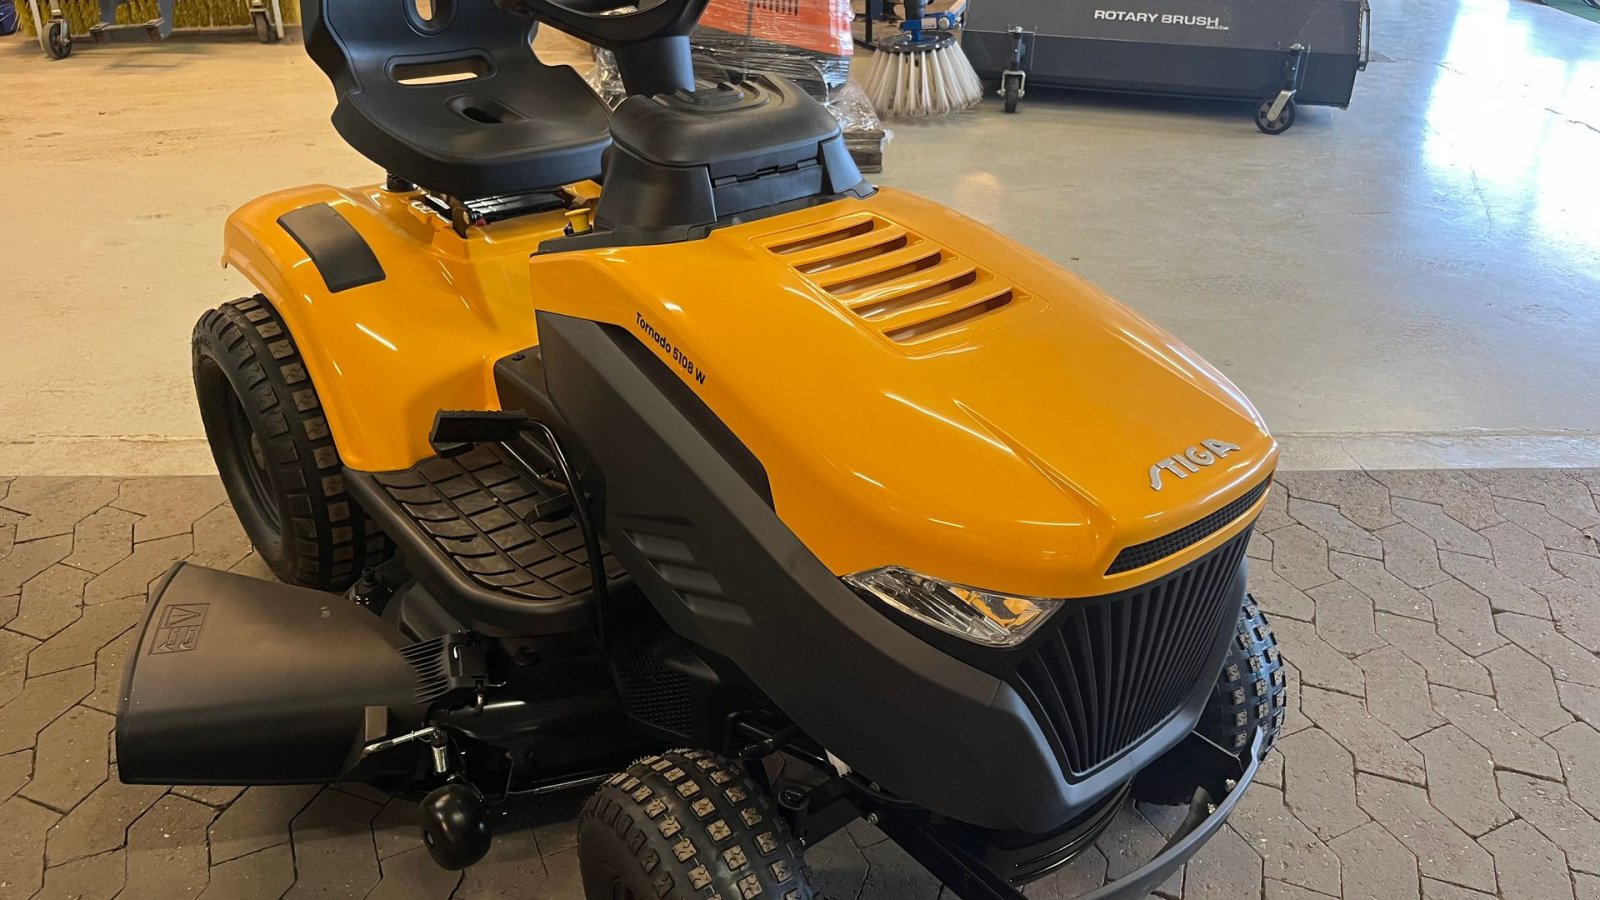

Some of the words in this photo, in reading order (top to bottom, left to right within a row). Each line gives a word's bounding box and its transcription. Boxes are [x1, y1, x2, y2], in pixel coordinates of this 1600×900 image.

[1094, 9, 1158, 23] ROTARY
[1161, 14, 1219, 27] BRUSH
[636, 311, 671, 353] Tornado
[672, 347, 694, 375] 5108
[695, 367, 706, 385] W
[1149, 438, 1241, 491] STIGA
